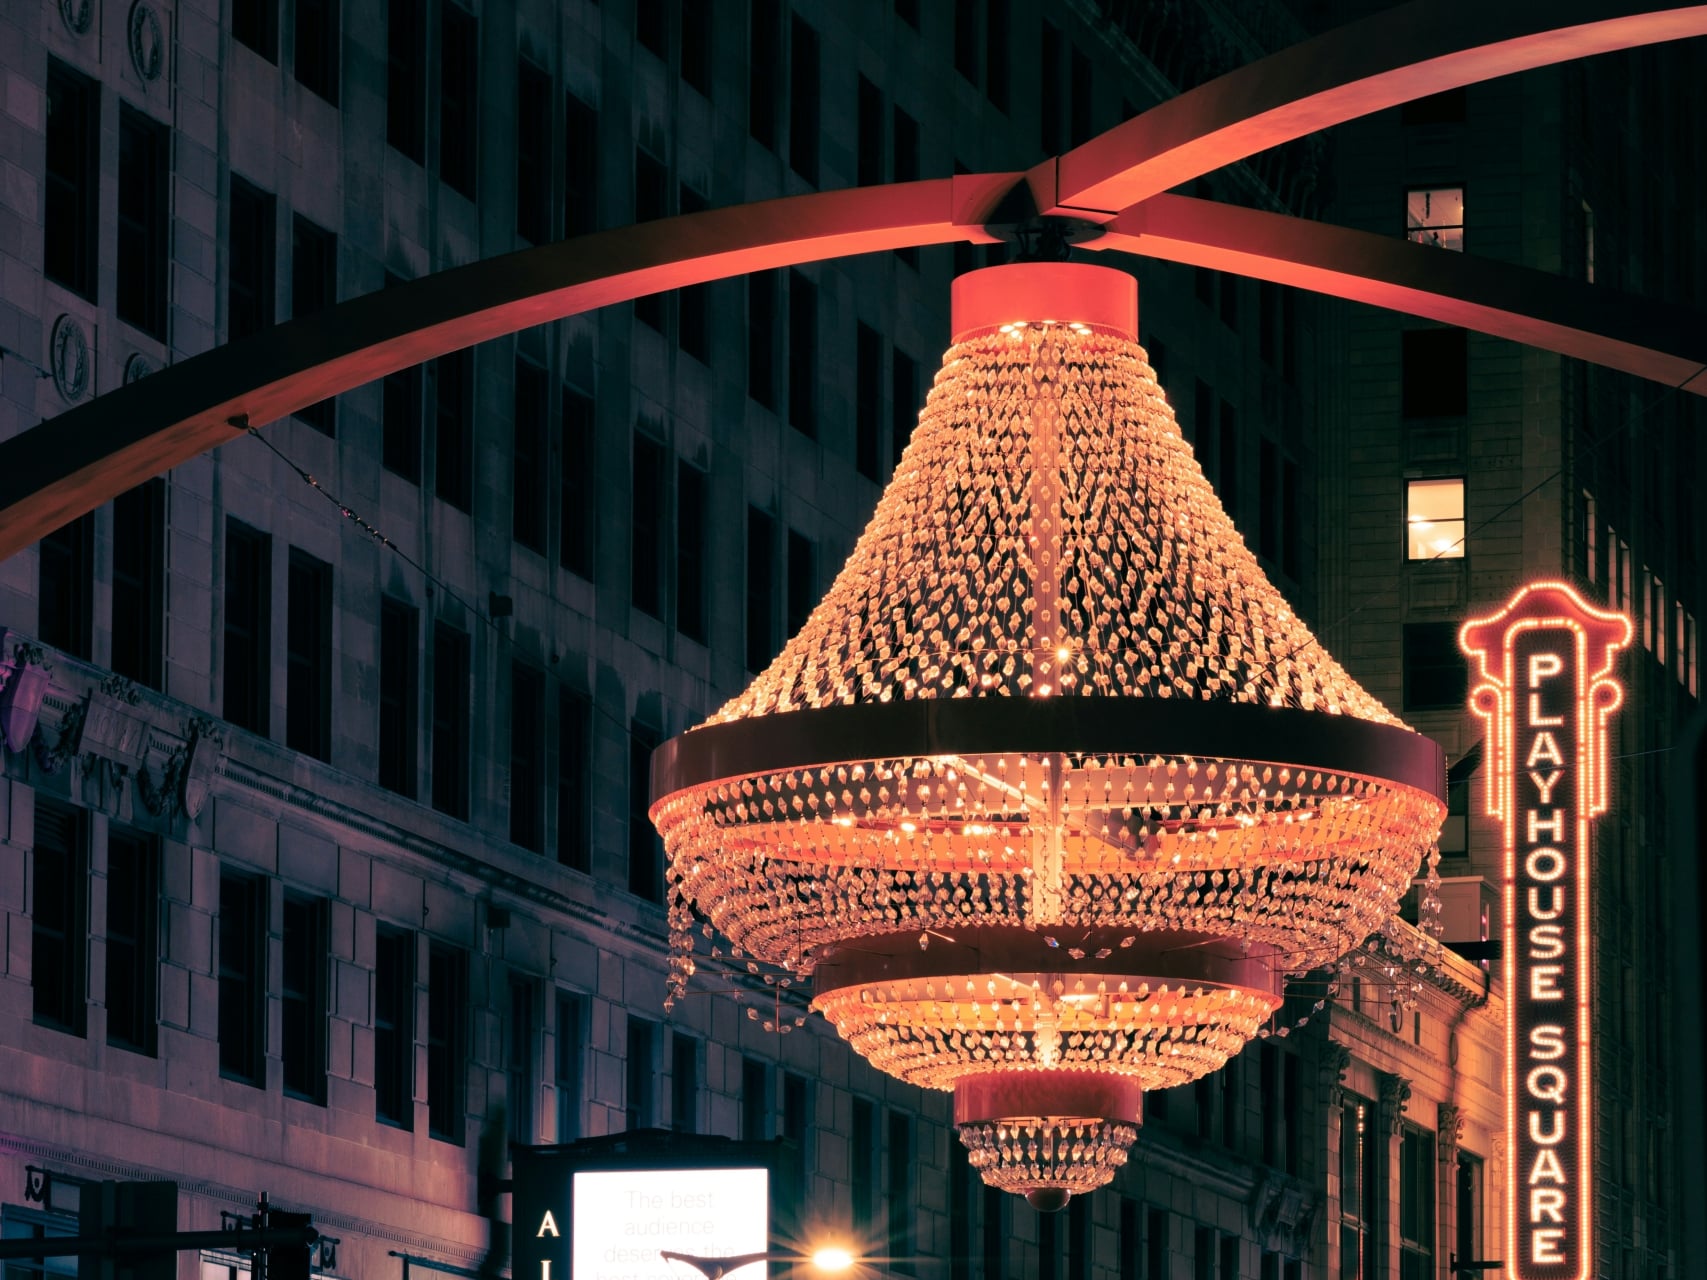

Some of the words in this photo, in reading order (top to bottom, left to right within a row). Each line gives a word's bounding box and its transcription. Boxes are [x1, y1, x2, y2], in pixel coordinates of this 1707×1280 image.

[1525, 653, 1567, 1000] PLAYHOUSE
[1526, 1024, 1568, 1264] SQUARE
[624, 1190, 663, 1208] The
[671, 1189, 714, 1208] best
[624, 1215, 714, 1236] audience
[603, 1243, 696, 1264] deser
